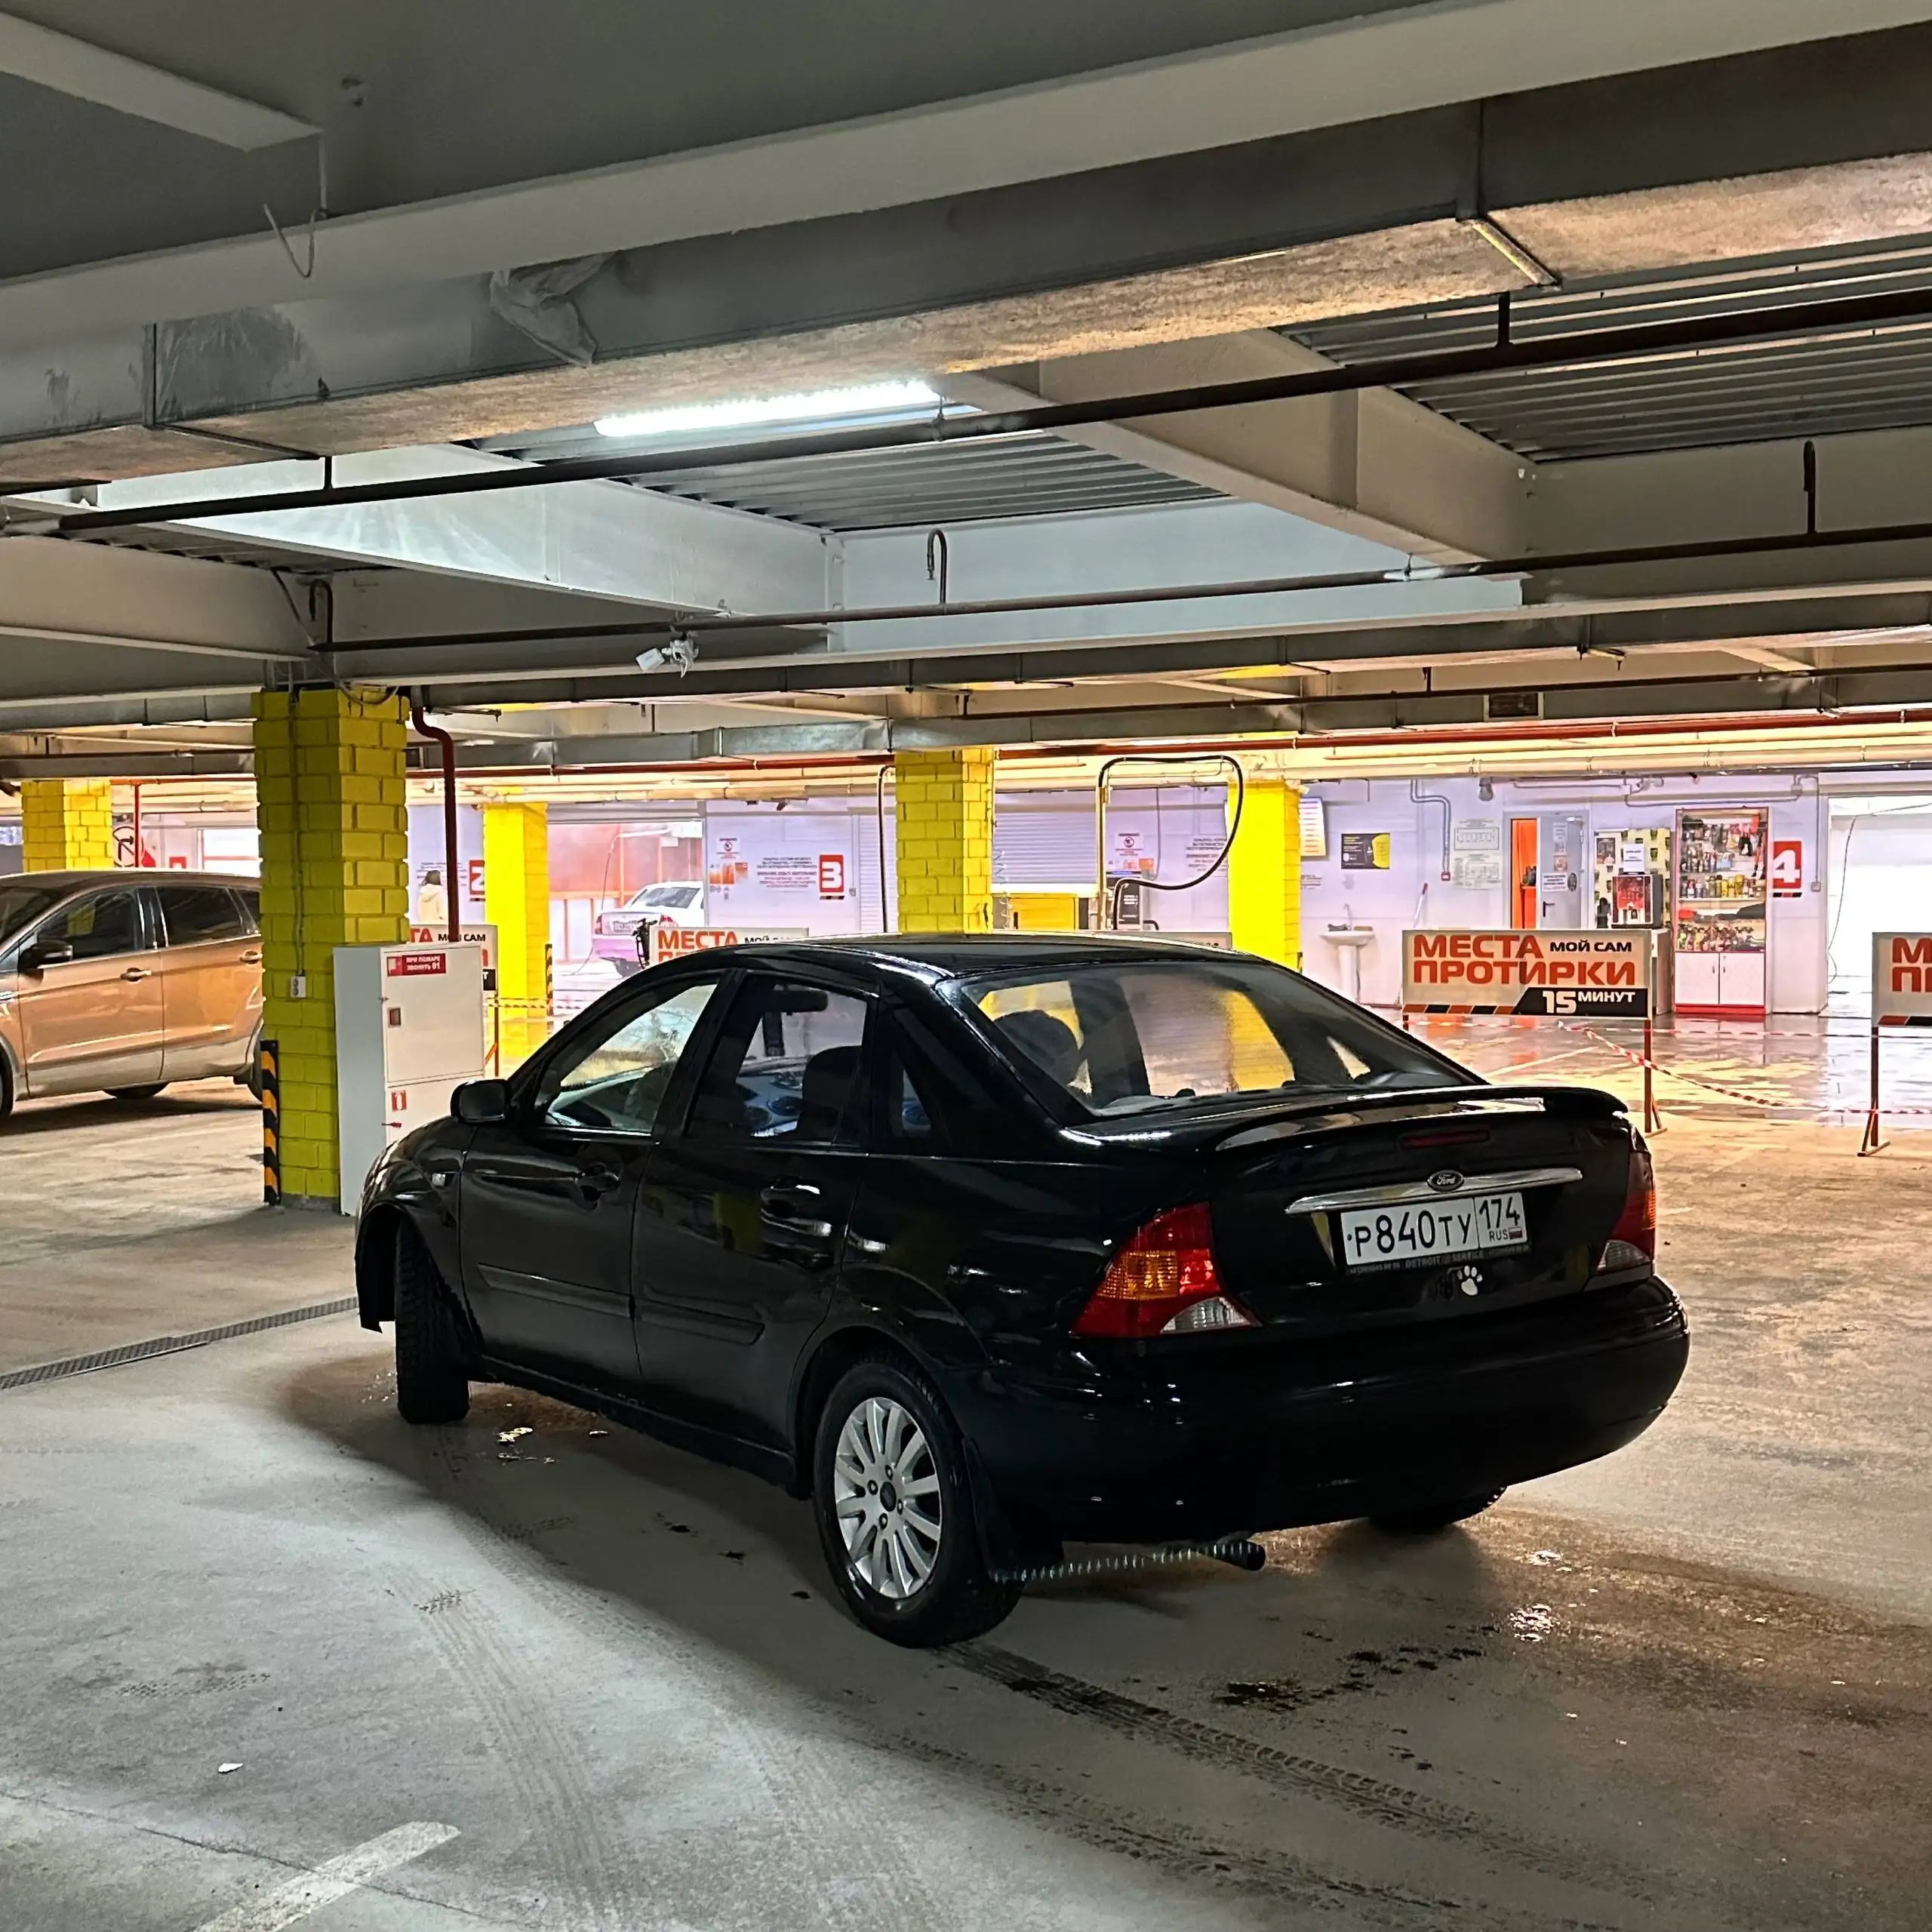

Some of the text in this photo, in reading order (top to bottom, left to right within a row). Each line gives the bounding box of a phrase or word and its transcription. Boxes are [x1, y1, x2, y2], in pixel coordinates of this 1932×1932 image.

[471, 866, 485, 891] 2
[822, 862, 842, 889] 3
[1774, 849, 1801, 884] 4
[463, 934, 486, 942] САМ
[657, 930, 738, 950] МЕСТА
[1414, 934, 1632, 958] МЕСТА МОЙ САМ
[1414, 960, 1635, 986] ПРОТИРКИ
[1542, 990, 1636, 1014] 15 МИНУТ
[1354, 1196, 1519, 1257] Р840ТУ 174
[1488, 1229, 1509, 1241] RUS
